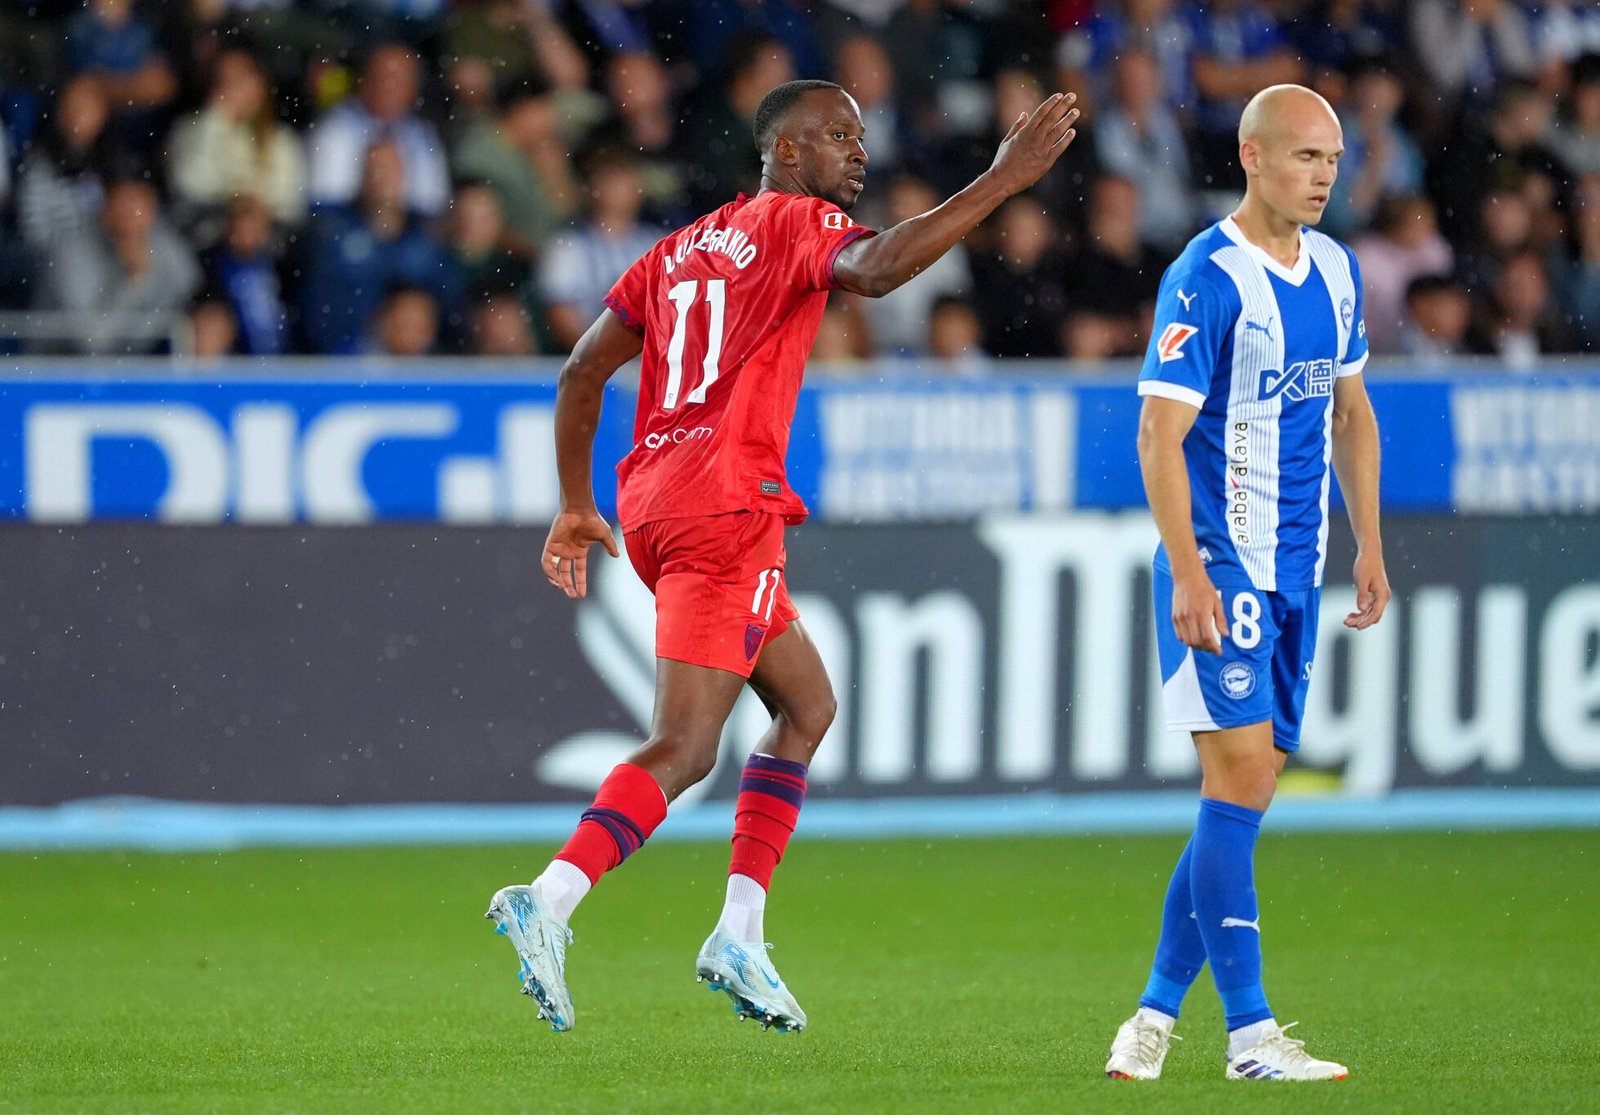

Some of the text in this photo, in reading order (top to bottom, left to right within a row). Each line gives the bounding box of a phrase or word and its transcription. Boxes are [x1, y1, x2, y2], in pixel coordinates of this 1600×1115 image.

[662, 278, 727, 410] 11
[1229, 421, 1249, 544] araba álava
[751, 567, 780, 622] 11
